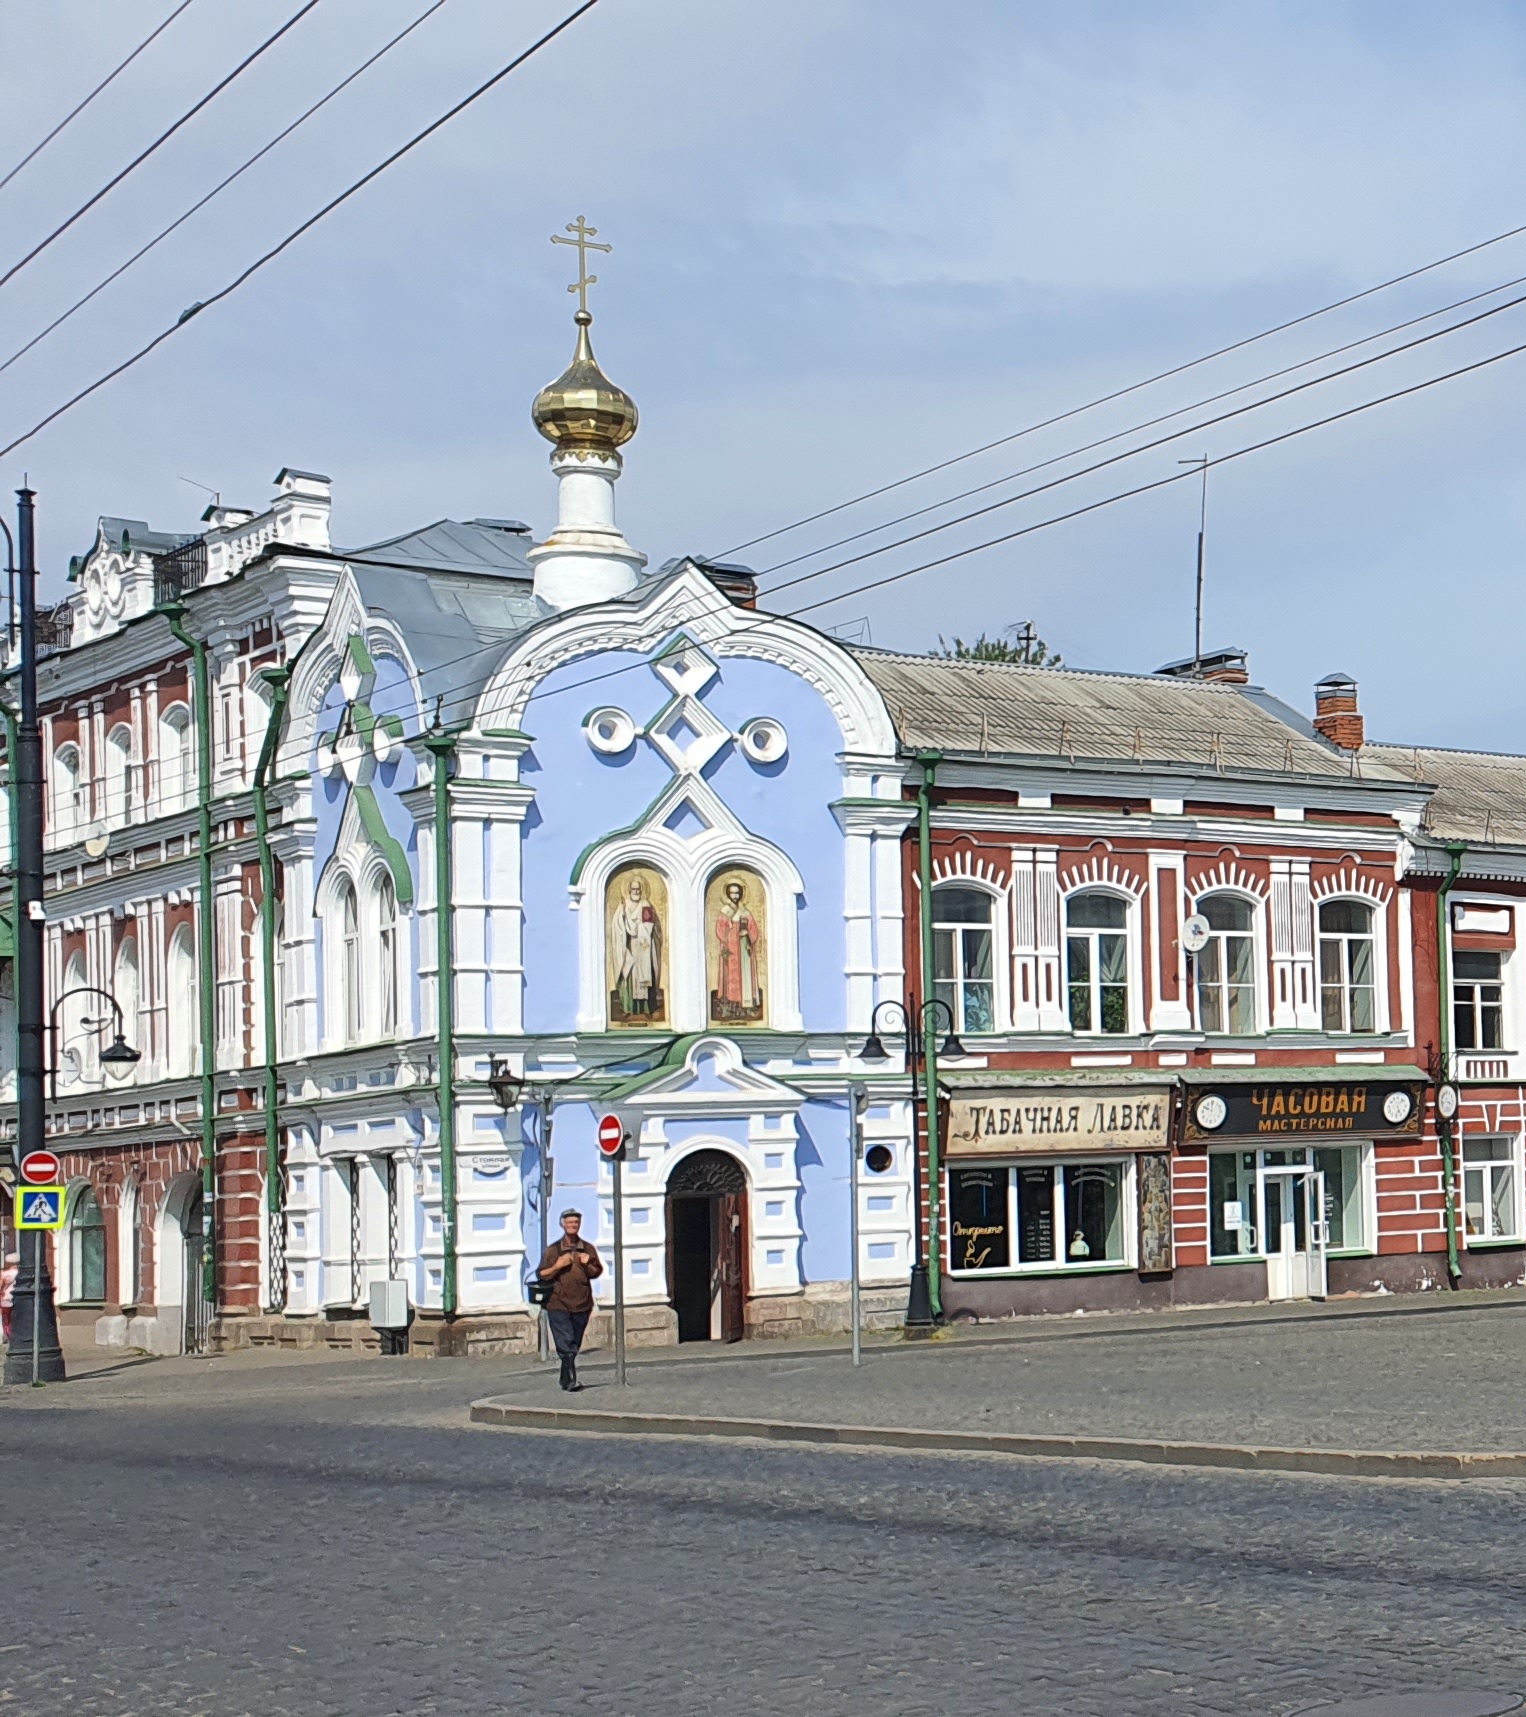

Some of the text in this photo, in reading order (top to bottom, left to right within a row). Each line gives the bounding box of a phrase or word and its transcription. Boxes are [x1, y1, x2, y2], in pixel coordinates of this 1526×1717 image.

[1252, 1087, 1367, 1116] ЧАСОВАЯ
[955, 1103, 1161, 1141] ТАБАЧНАЯ ЛАВКА
[1259, 1117, 1354, 1131] МАСТЕРСКАЯ
